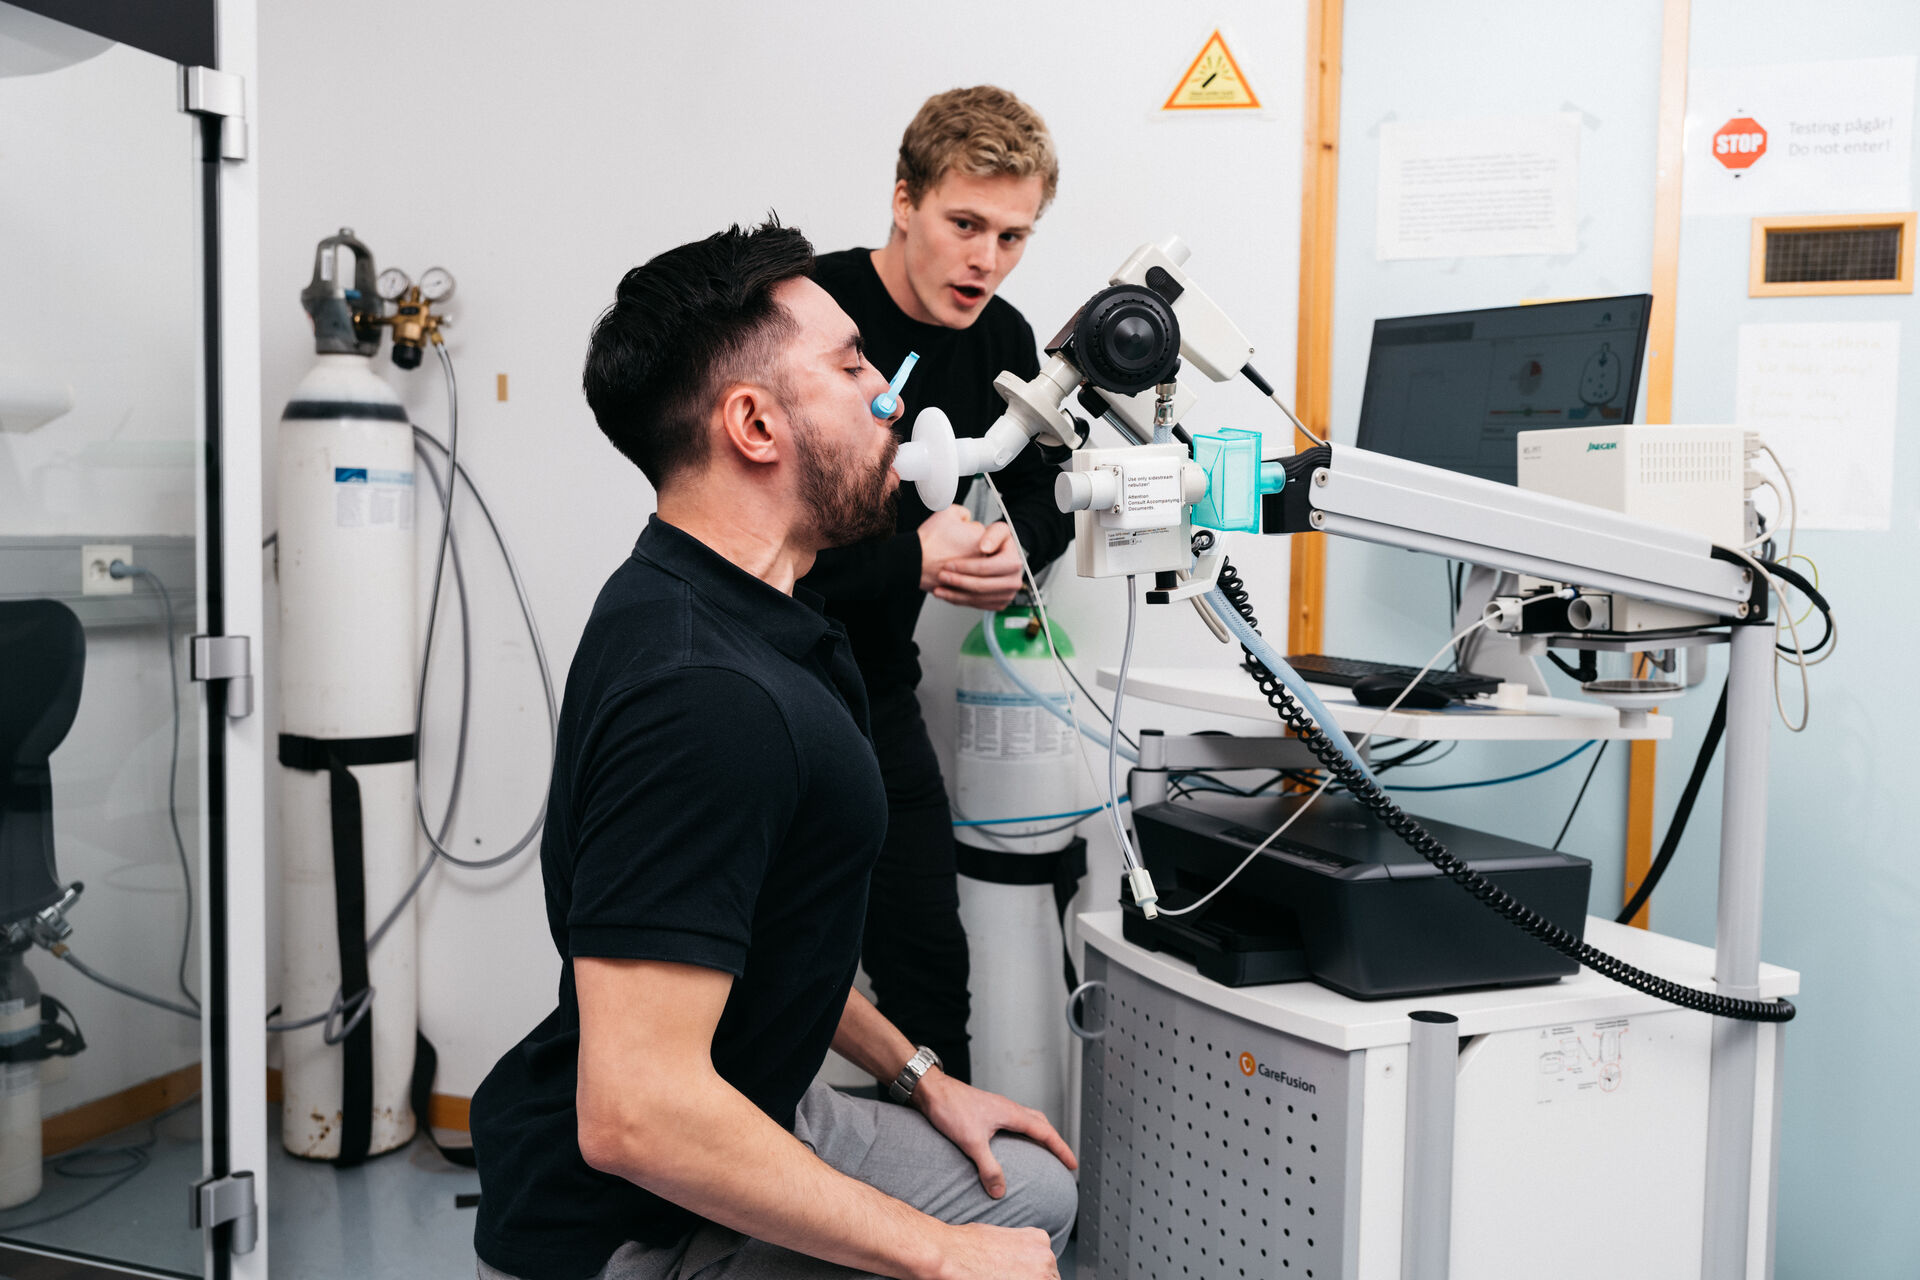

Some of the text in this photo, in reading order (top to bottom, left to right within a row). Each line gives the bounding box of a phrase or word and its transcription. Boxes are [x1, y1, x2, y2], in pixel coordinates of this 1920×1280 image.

[1788, 120, 1840, 136] Testing
[1715, 132, 1764, 155] STOP
[1788, 139, 1891, 157] Do not enter!
[1258, 1063, 1316, 1095] CareFusion
